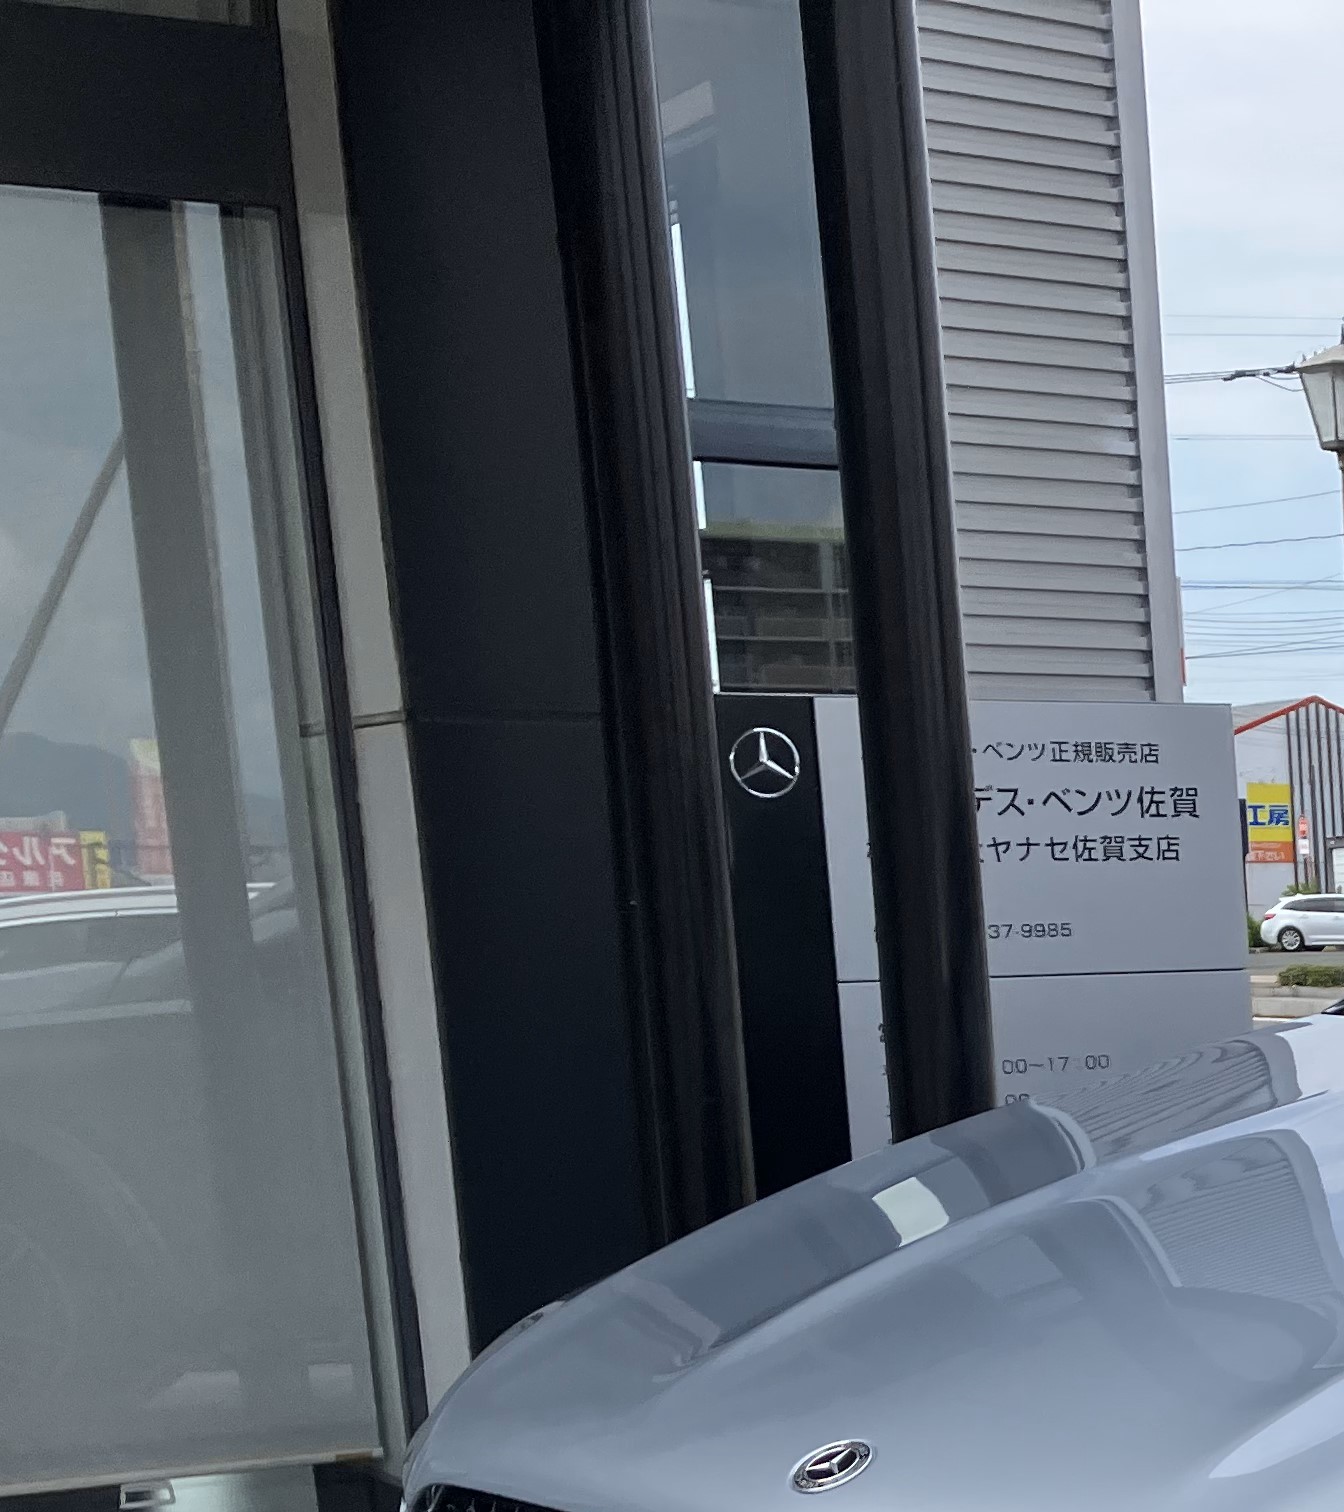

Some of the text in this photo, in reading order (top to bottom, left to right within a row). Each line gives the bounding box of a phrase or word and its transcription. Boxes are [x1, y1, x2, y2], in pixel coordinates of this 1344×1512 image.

[979, 835, 1181, 863] ヤナセ佐賀支店
